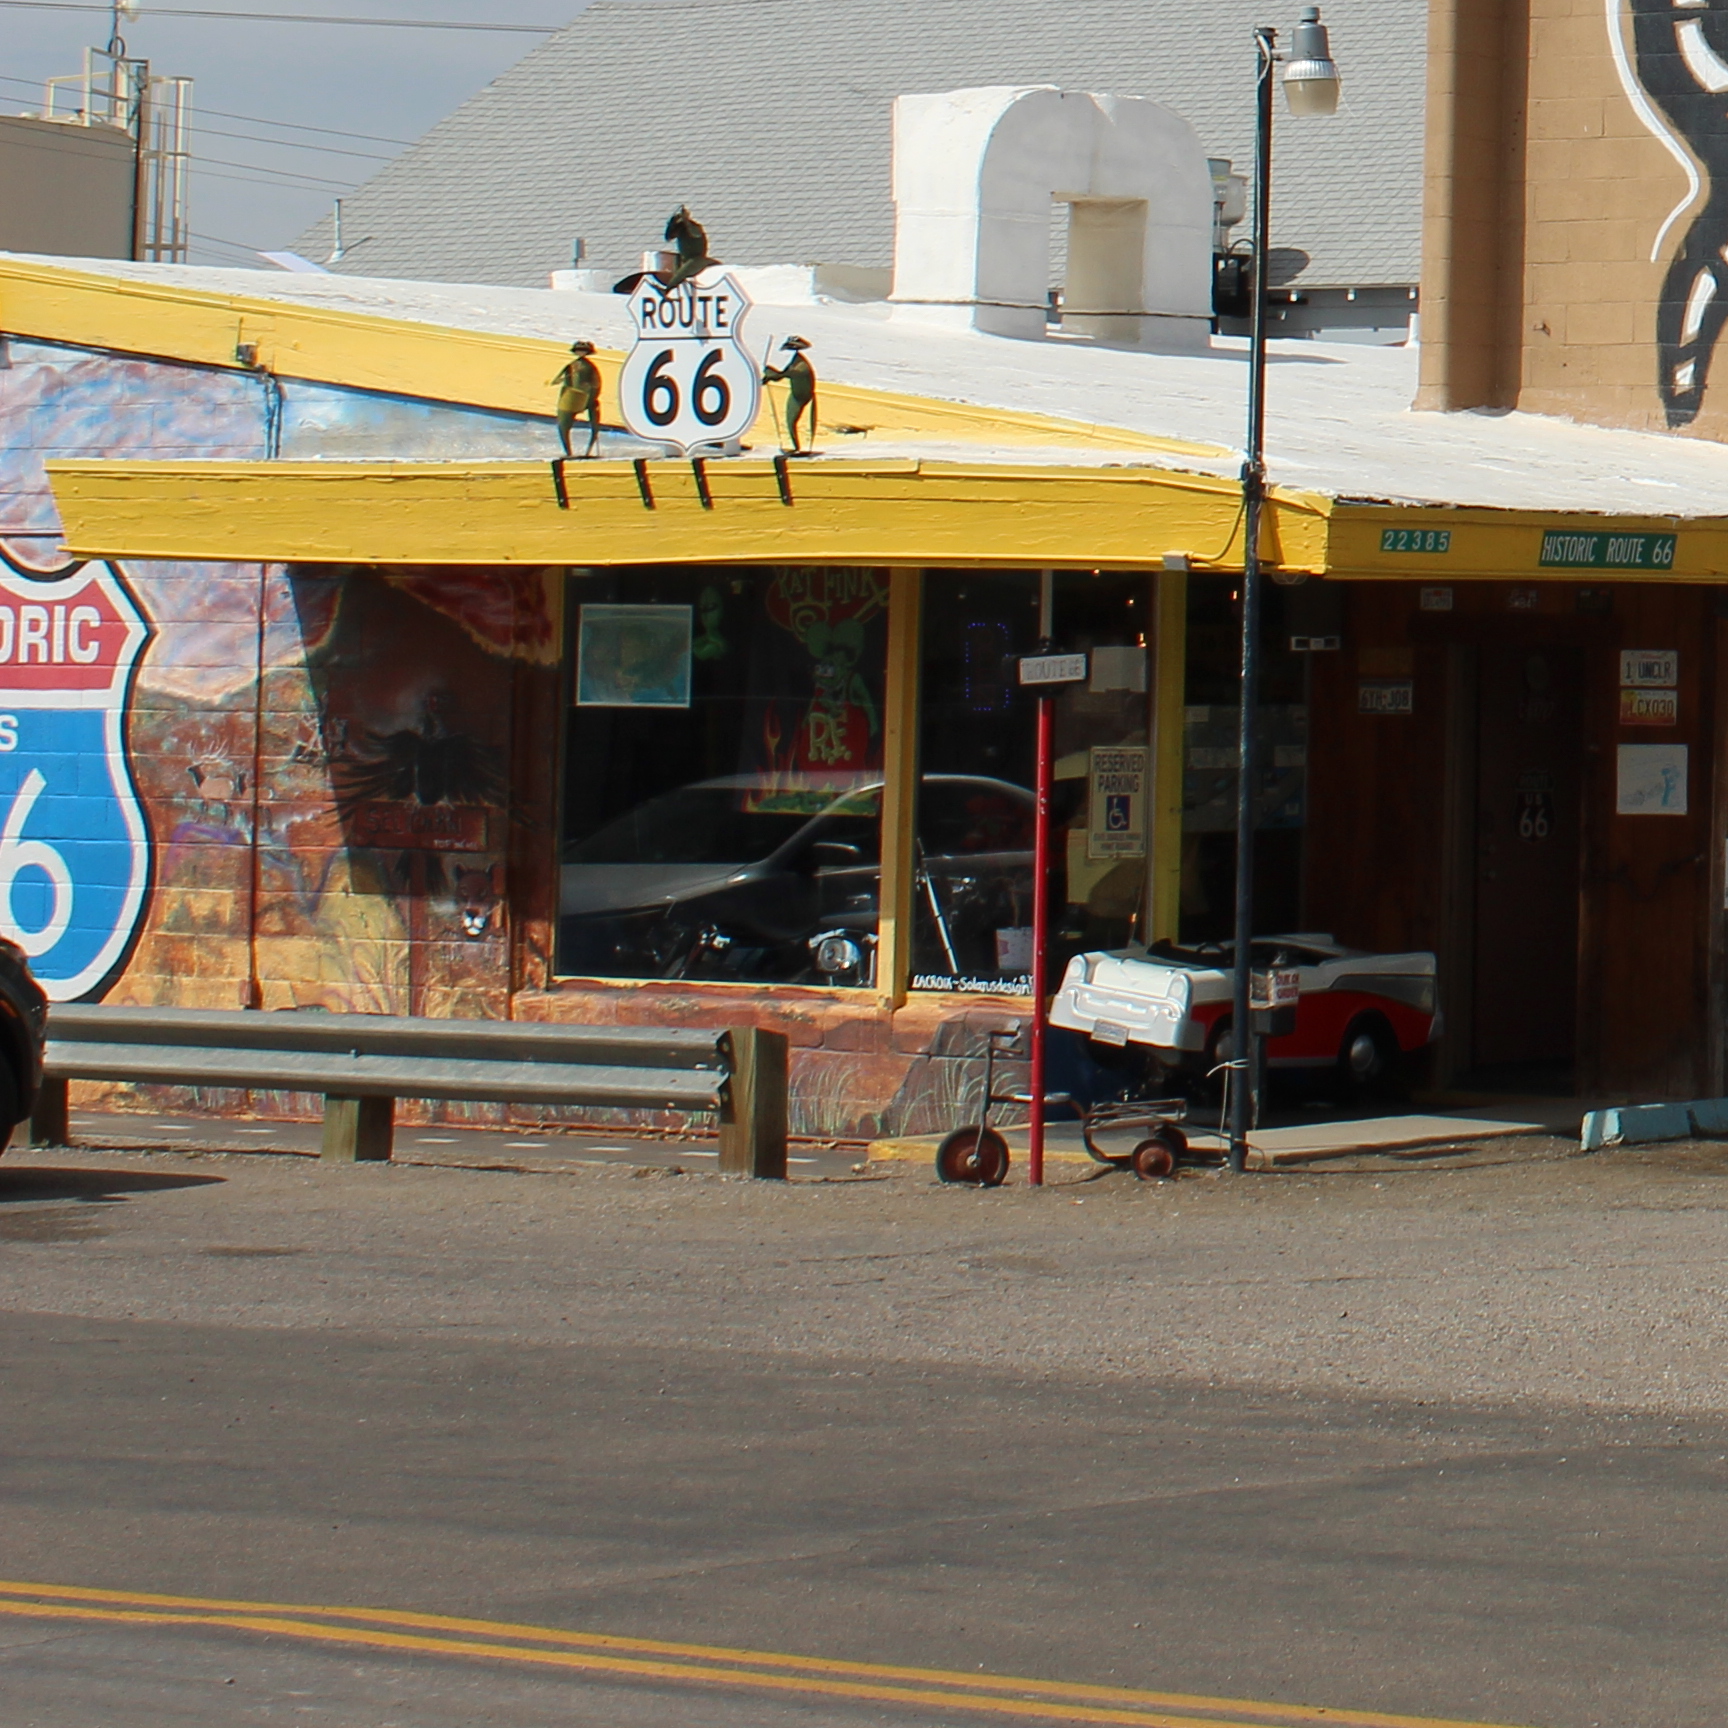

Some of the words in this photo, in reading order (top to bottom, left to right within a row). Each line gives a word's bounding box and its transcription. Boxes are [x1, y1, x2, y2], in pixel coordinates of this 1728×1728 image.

[641, 295, 729, 328] ROUTE
[642, 347, 731, 427] 66
[1383, 531, 1449, 551] 22385
[1541, 535, 1598, 562] HISTORIC
[1605, 537, 1644, 564] ROUTE
[1652, 539, 1673, 564] 66
[1095, 754, 1144, 773] RESERVED
[1098, 774, 1140, 793] PARKING
[1519, 807, 1549, 838] 66
